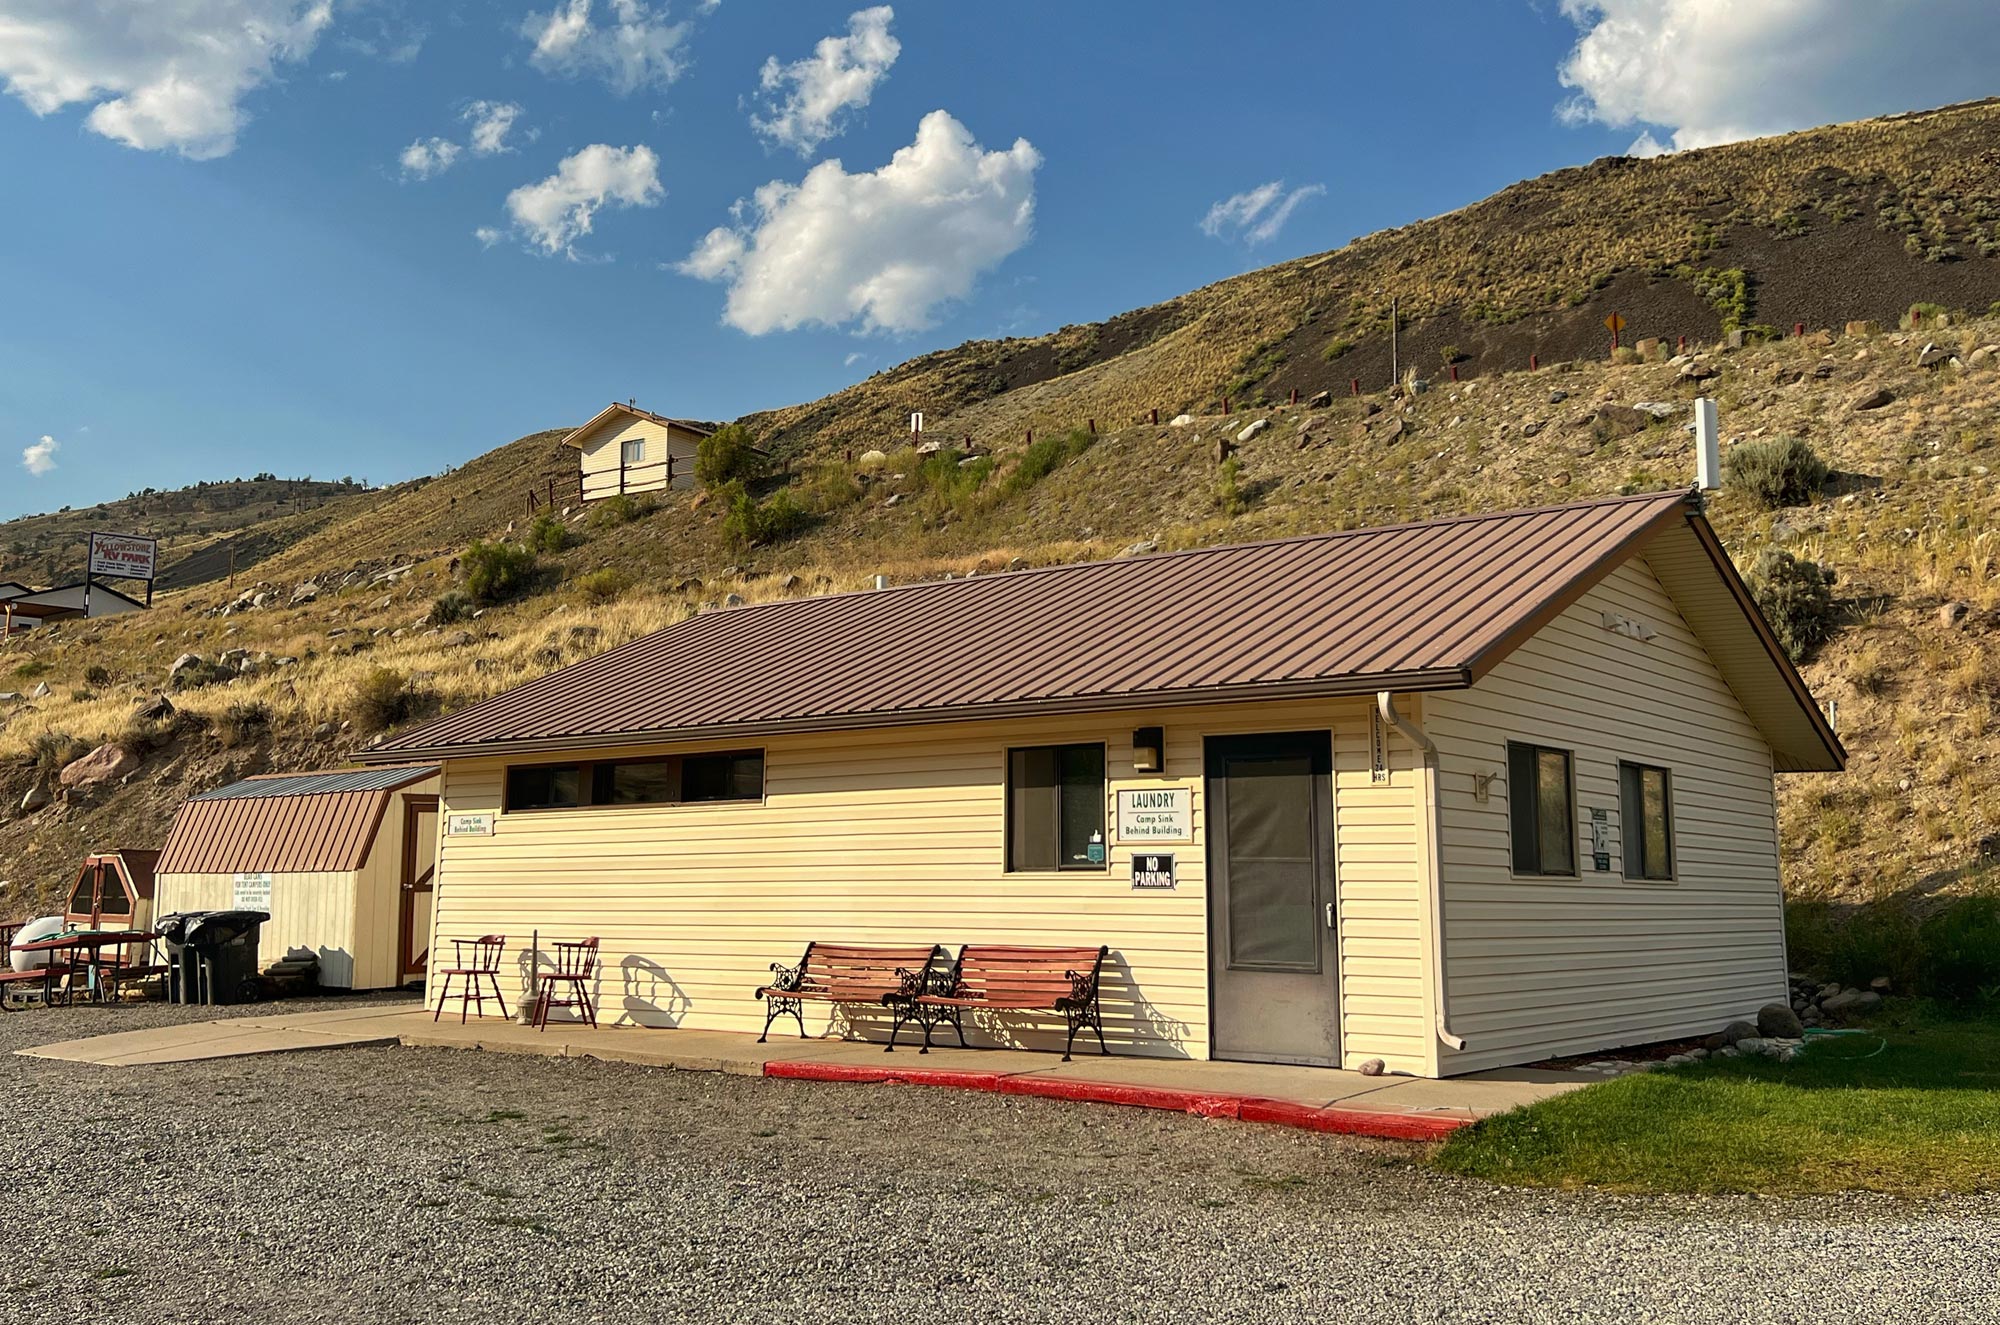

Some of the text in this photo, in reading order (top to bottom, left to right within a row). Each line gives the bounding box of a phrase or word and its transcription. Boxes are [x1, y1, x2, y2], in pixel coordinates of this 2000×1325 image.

[94, 541, 151, 554] YELLOWSTONE
[103, 549, 120, 561] RV
[121, 552, 151, 565] PARK
[1132, 792, 1175, 808] LAUNDRY
[460, 817, 472, 825] Camp
[1136, 814, 1174, 824] Camp Sink
[1125, 826, 1182, 836] Behind Building
[1146, 856, 1159, 871] NO
[1135, 871, 1171, 886] PARKING
